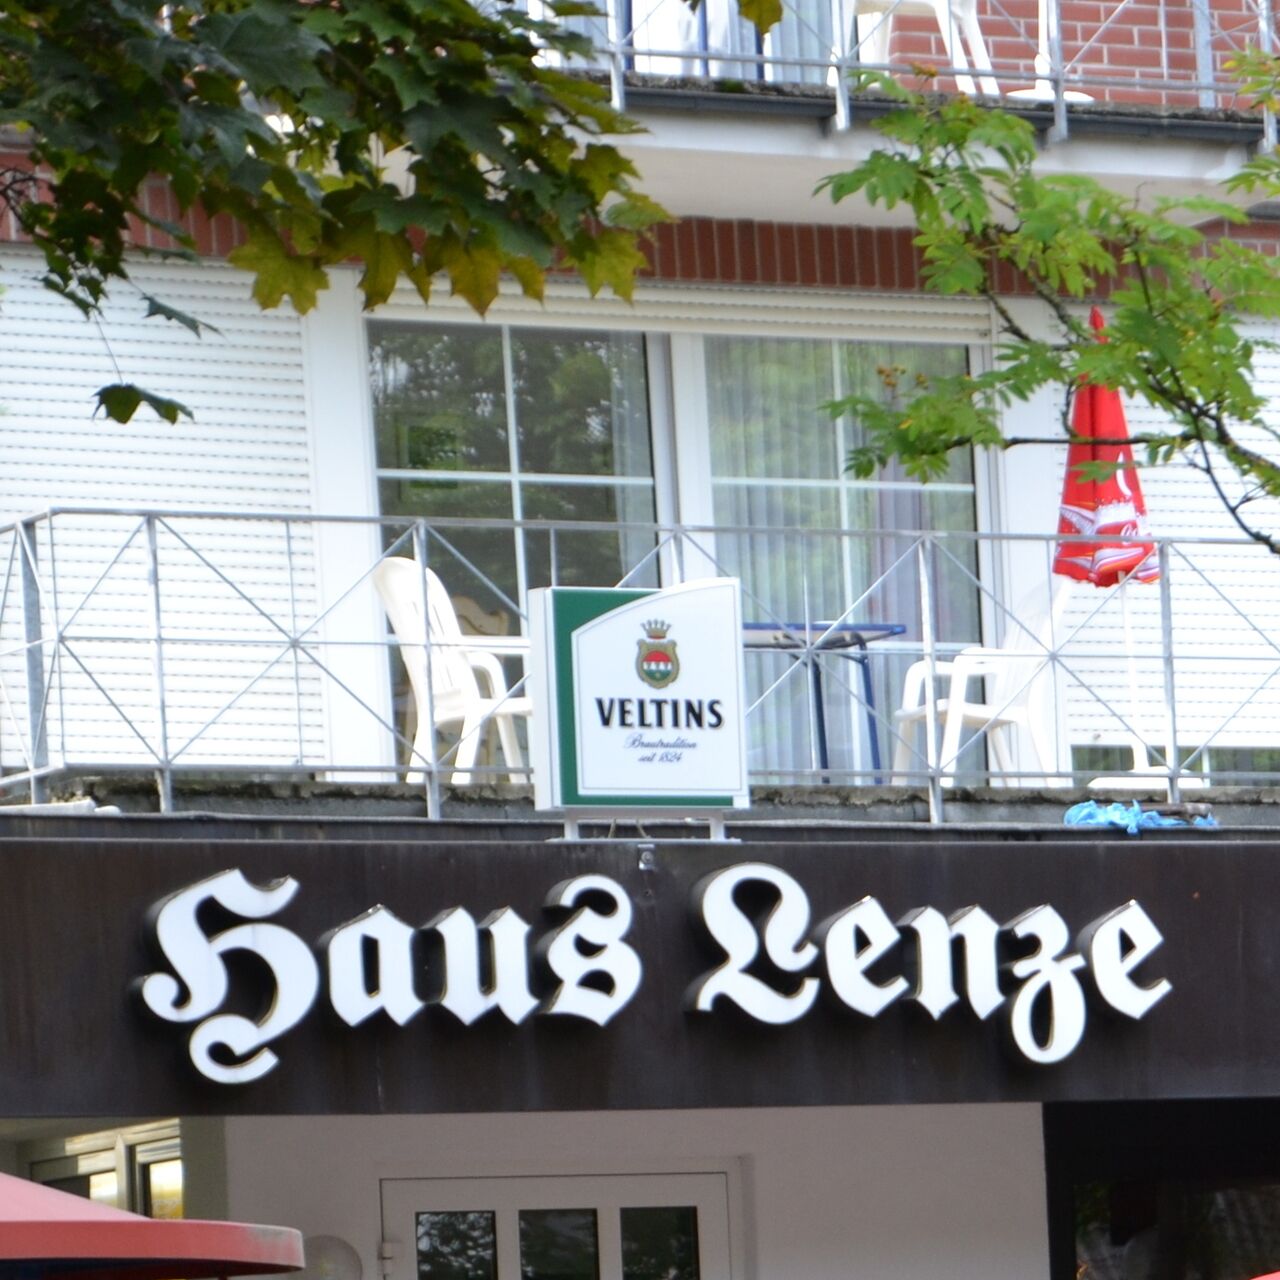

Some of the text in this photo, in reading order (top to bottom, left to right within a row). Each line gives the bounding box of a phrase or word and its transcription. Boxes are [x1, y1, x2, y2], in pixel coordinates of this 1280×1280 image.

[595, 697, 725, 729] VELTINS
[139, 861, 1173, 1085] Haus Lenze
